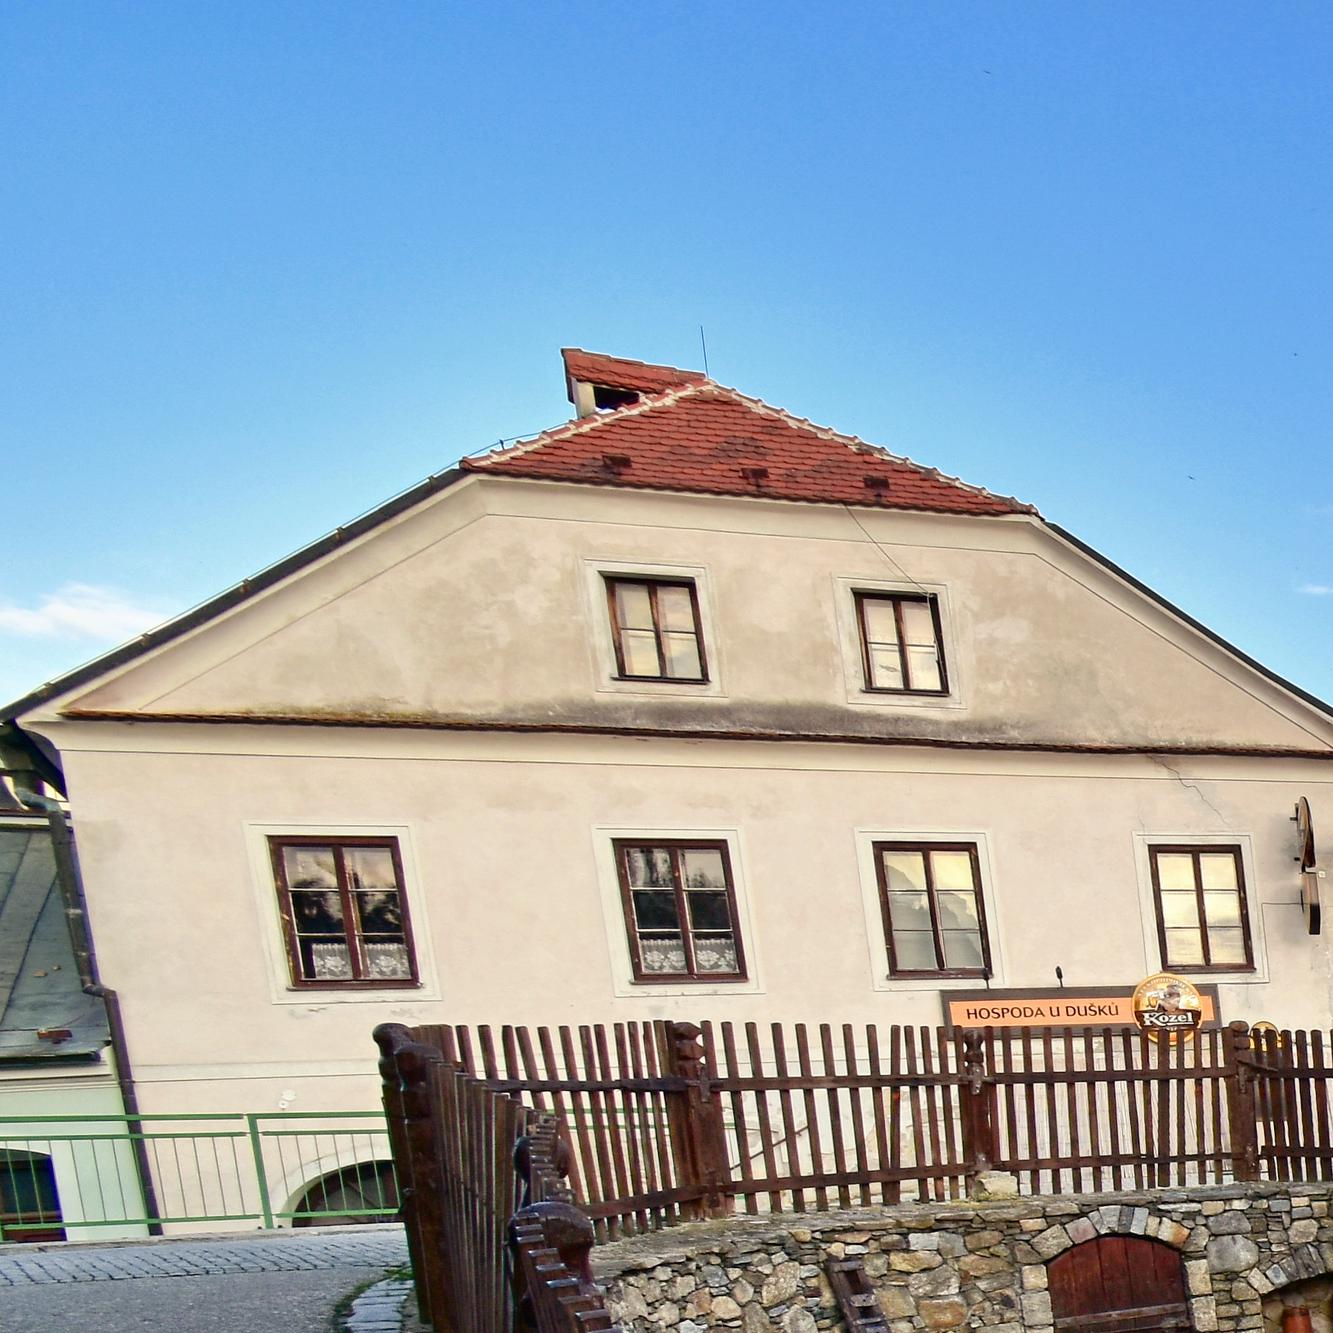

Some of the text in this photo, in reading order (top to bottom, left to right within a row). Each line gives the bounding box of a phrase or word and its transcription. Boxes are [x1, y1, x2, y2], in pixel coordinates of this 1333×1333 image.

[967, 1006, 1044, 1020] HOSPODA
[1050, 1005, 1060, 1017] U
[1142, 1012, 1194, 1026] Kozel
